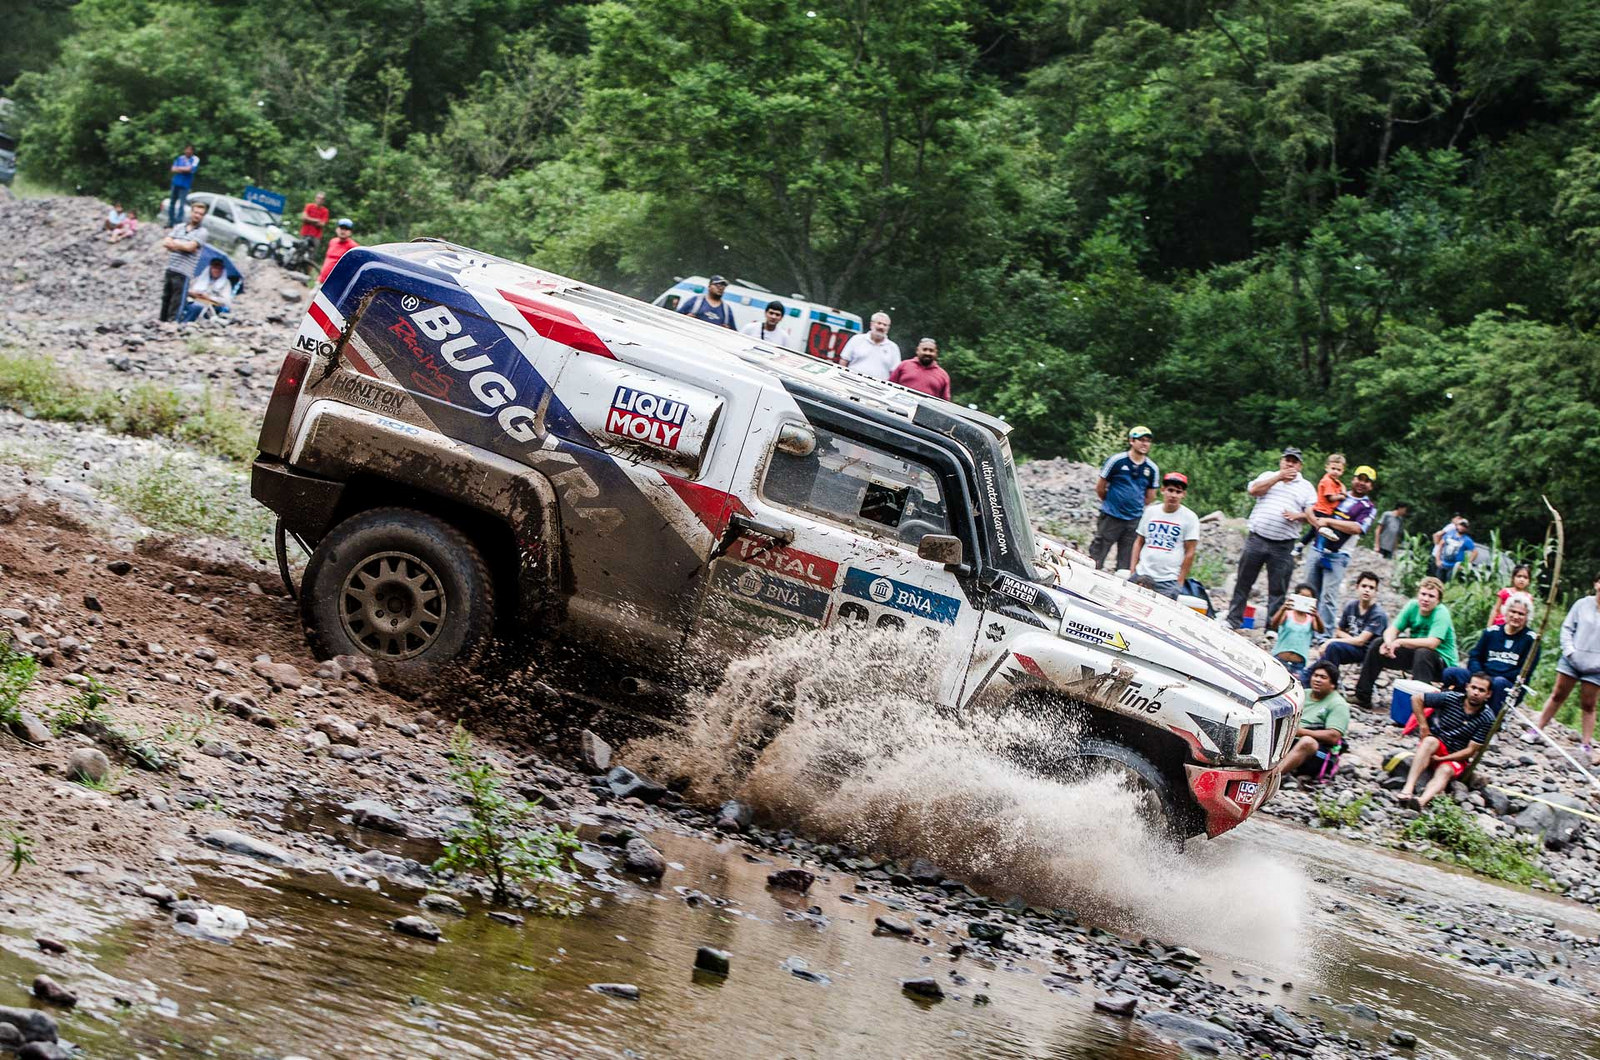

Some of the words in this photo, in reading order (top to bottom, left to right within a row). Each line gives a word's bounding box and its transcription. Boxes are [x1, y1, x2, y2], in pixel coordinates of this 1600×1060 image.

[331, 374, 406, 409] HONITON
[380, 403, 402, 416] TOOLS
[614, 388, 687, 425] LIQUI
[609, 411, 681, 446] MOLY
[981, 460, 1009, 556] ultimatedakar.com
[1148, 522, 1182, 537] DNS
[738, 537, 821, 581] TOTAL
[766, 584, 800, 607] BNA
[1001, 585, 1034, 603] FILTER
[1004, 576, 1037, 597] MANN
[896, 590, 932, 614] BNA
[1068, 620, 1115, 640] agados
